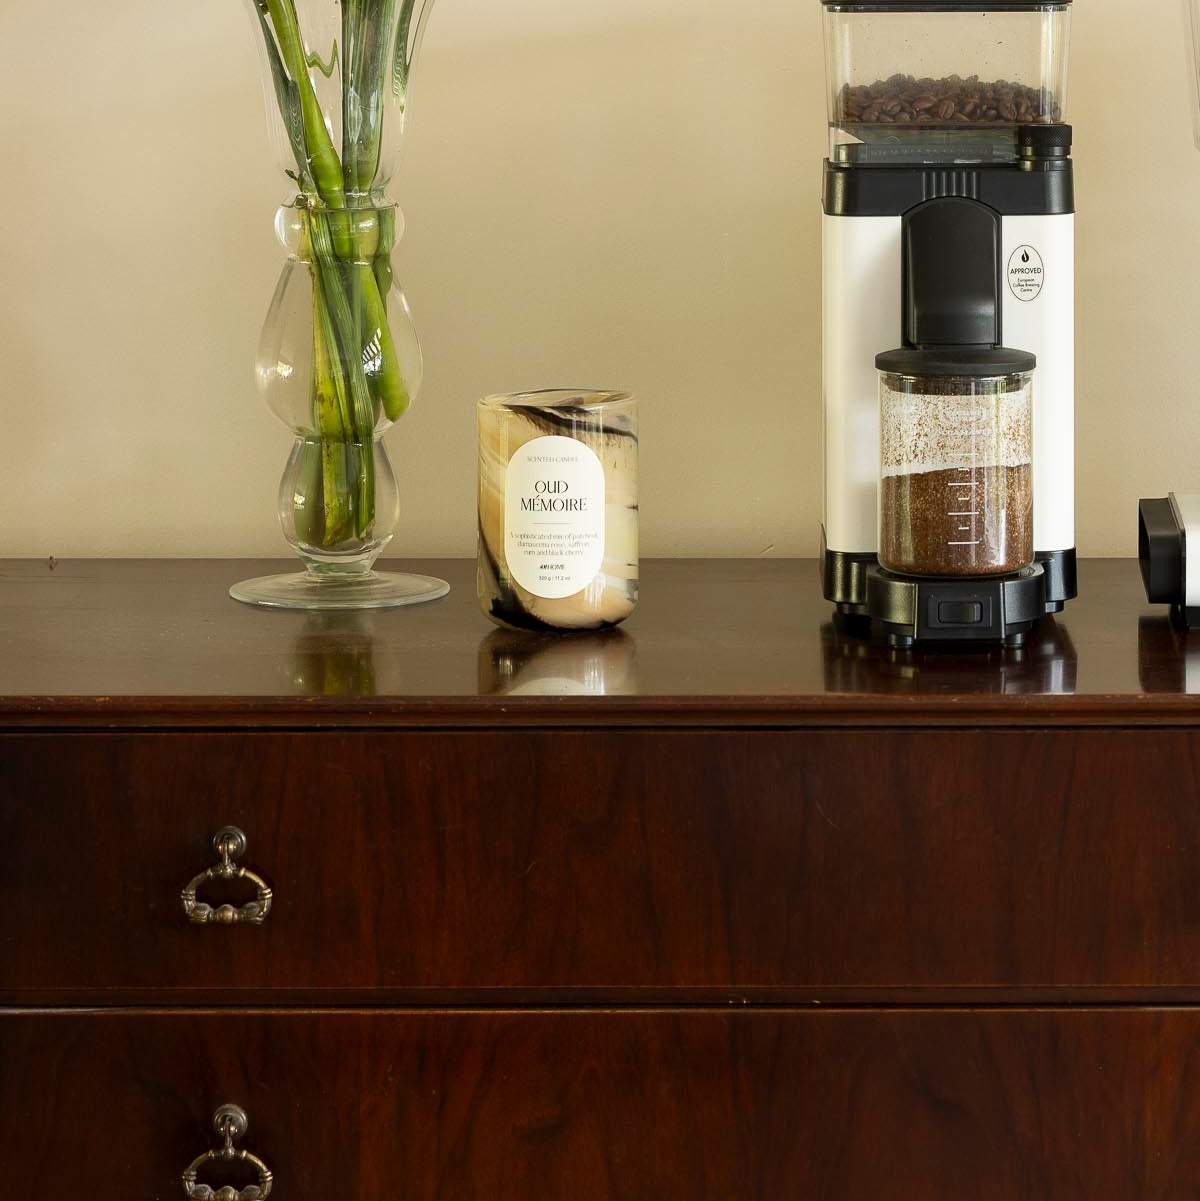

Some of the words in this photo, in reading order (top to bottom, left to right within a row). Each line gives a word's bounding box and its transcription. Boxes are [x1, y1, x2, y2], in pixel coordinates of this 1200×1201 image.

[1010, 267, 1042, 275] APPROVED
[534, 480, 569, 494] OUD
[520, 494, 589, 512] MÉMOIRE
